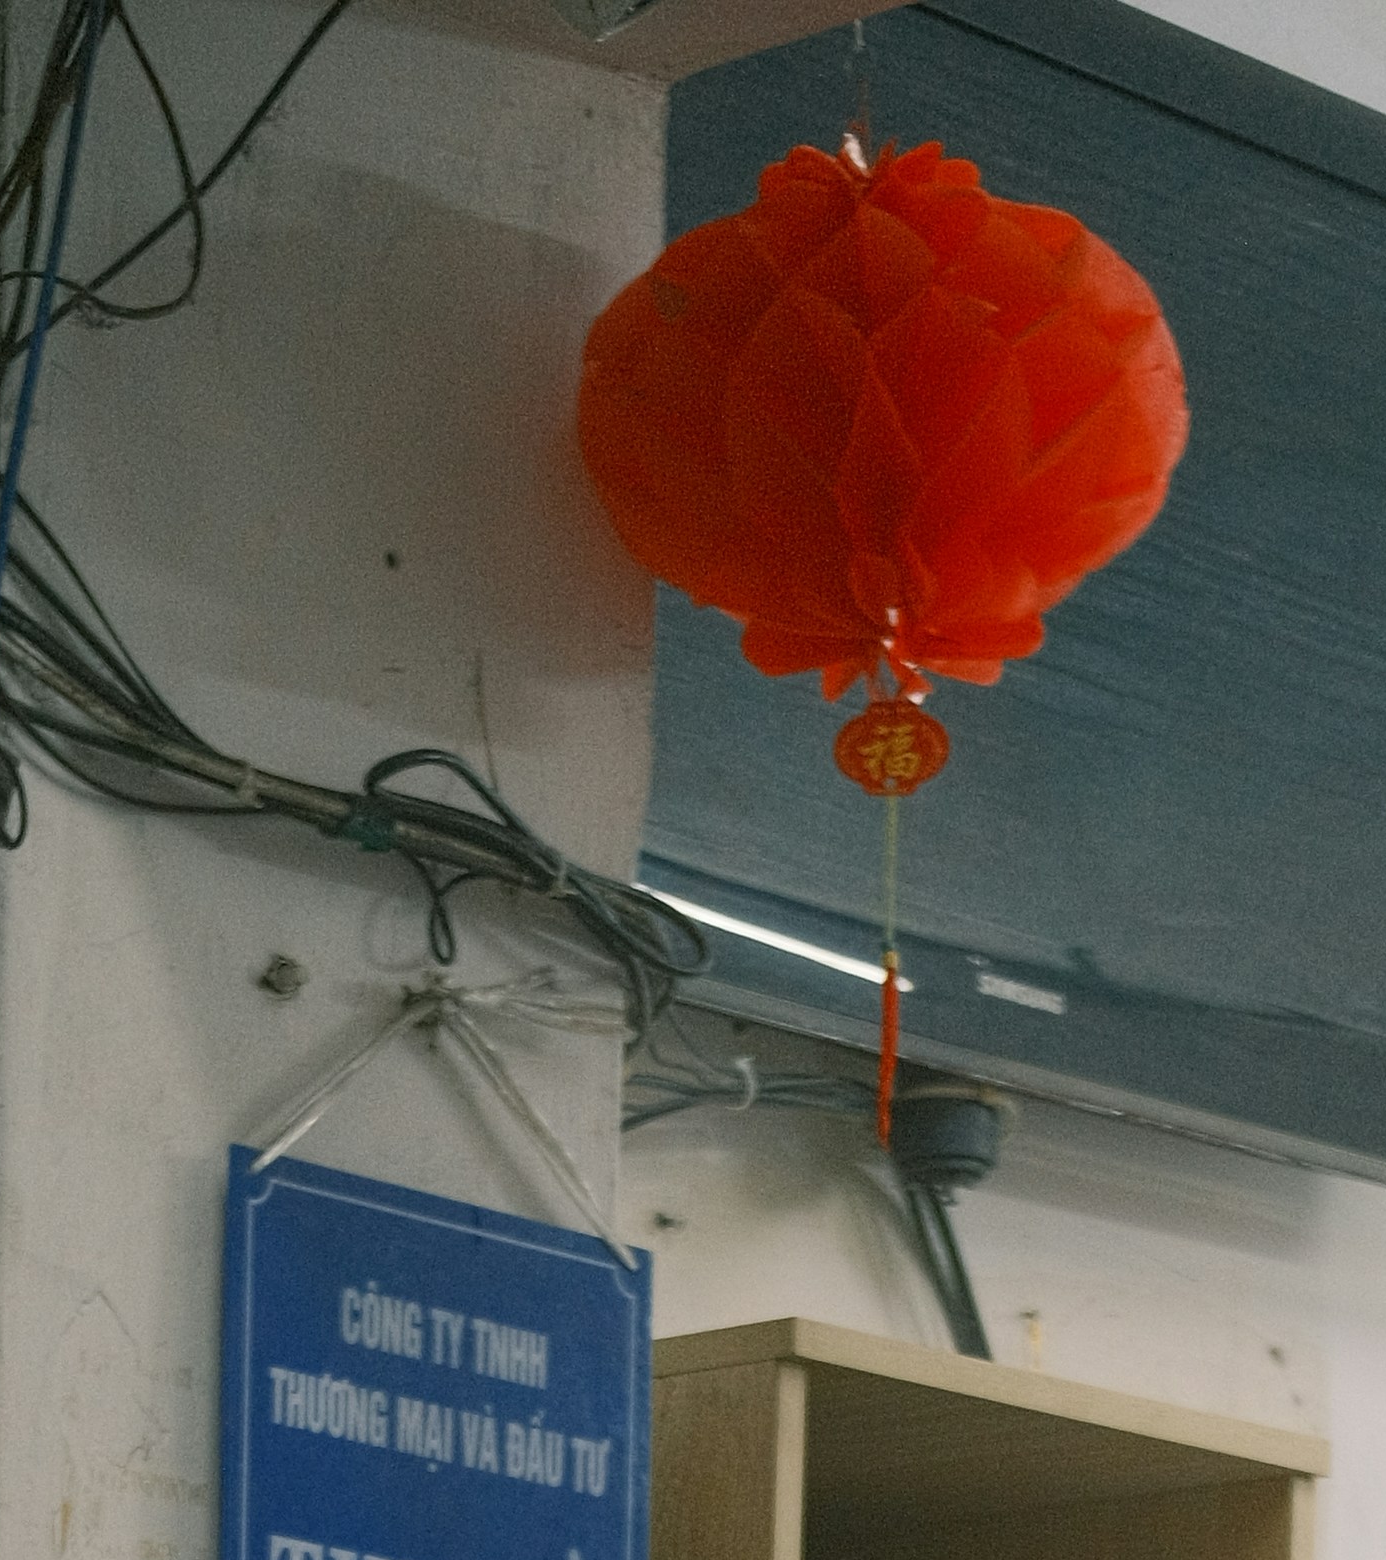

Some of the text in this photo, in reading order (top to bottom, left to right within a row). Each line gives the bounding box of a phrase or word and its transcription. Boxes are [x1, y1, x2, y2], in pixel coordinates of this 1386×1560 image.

[860, 724, 920, 779] 福
[341, 1281, 549, 1390] CÔNG TY TNHH
[396, 1396, 454, 1474] MẠI
[461, 1404, 500, 1474] VÀ
